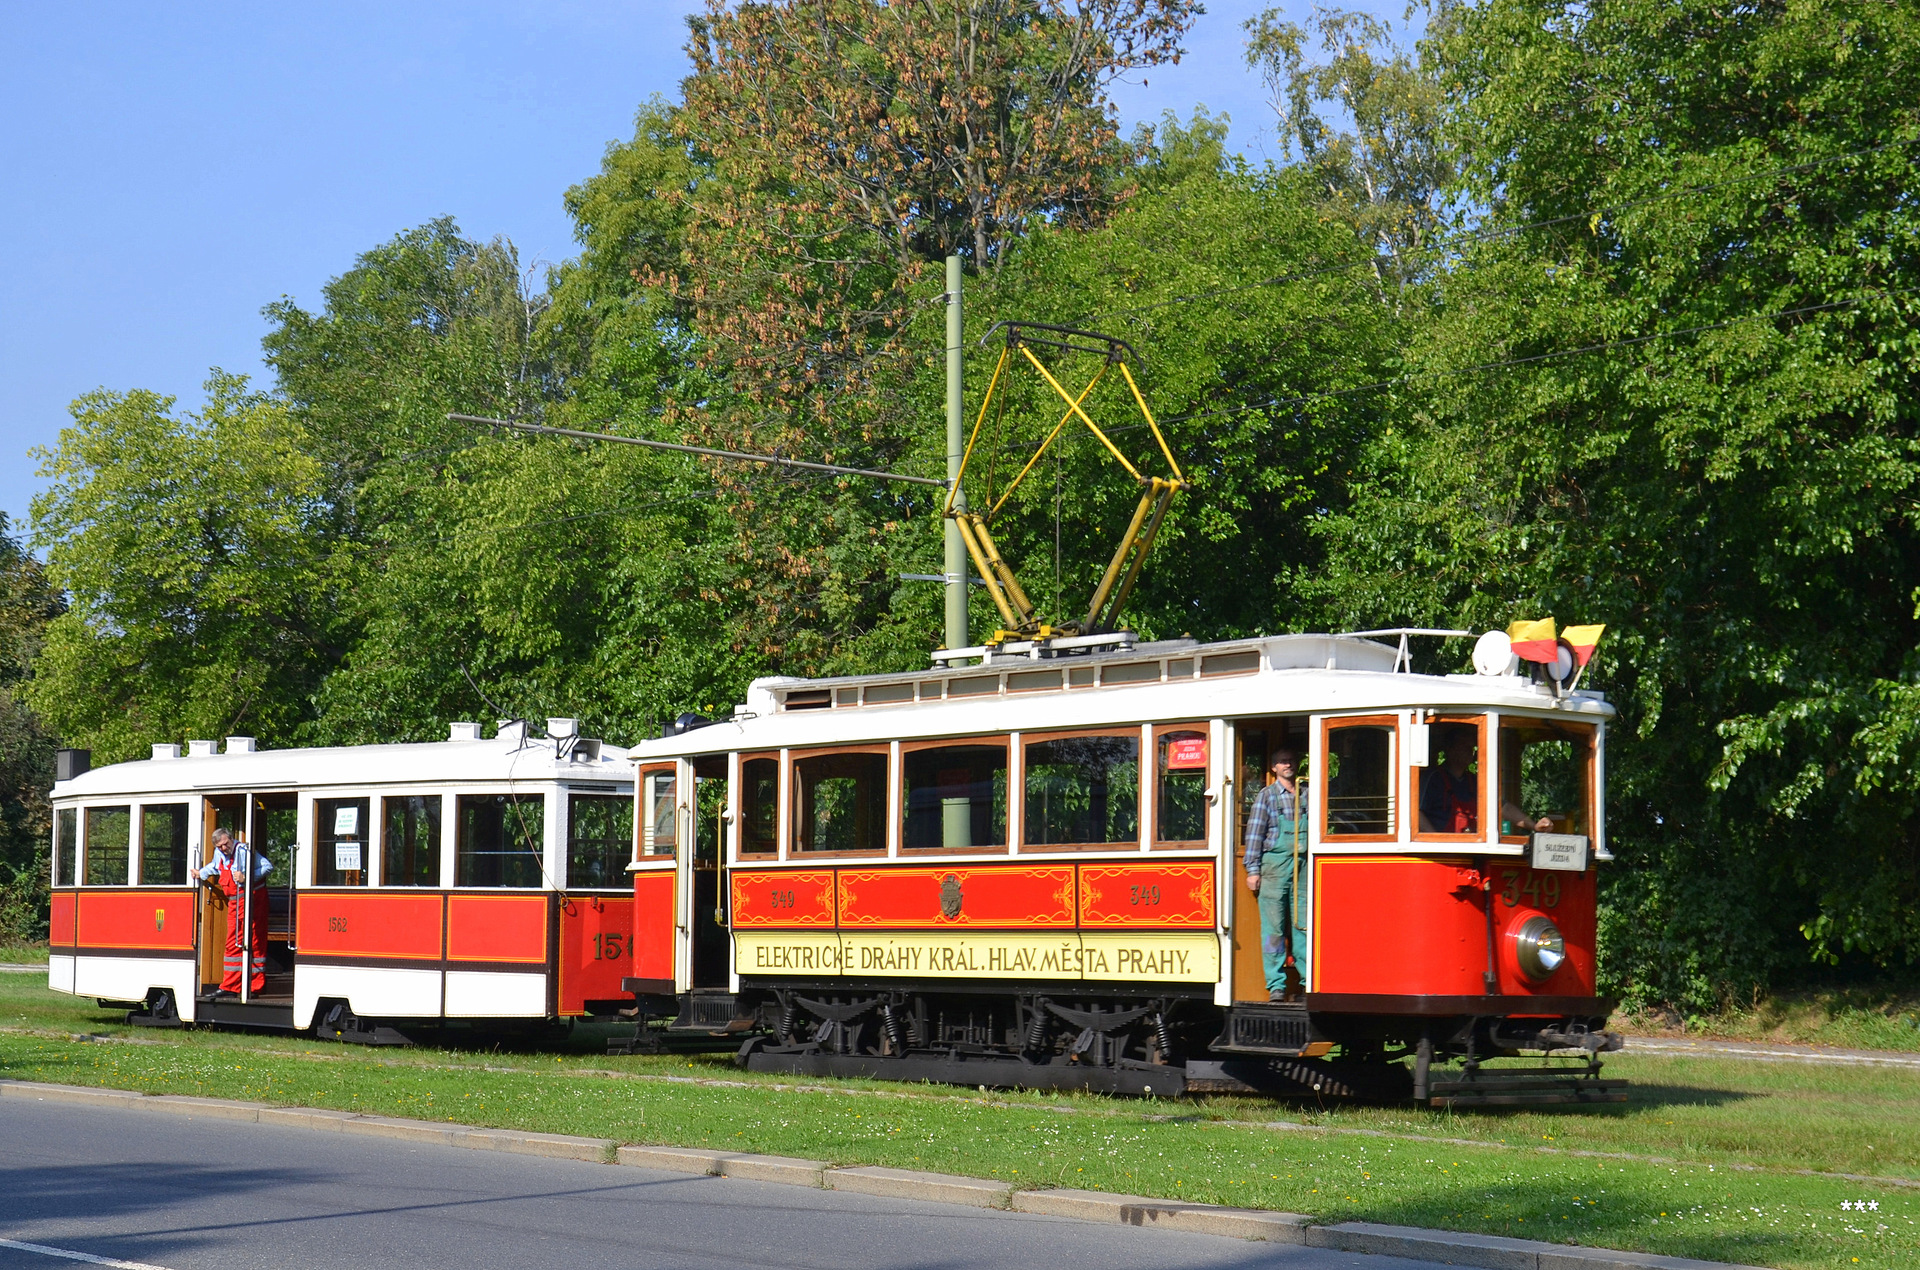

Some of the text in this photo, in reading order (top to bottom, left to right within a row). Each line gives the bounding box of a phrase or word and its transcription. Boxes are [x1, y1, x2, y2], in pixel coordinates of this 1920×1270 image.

[771, 890, 795, 908] 349
[1129, 885, 1161, 905] 349
[1501, 871, 1561, 908] 349
[328, 917, 348, 932] 1562
[756, 940, 1192, 974] ELEKTRICKÉ DRÁHY KRÁL. HLAV. MĚSTA PRAHY.
